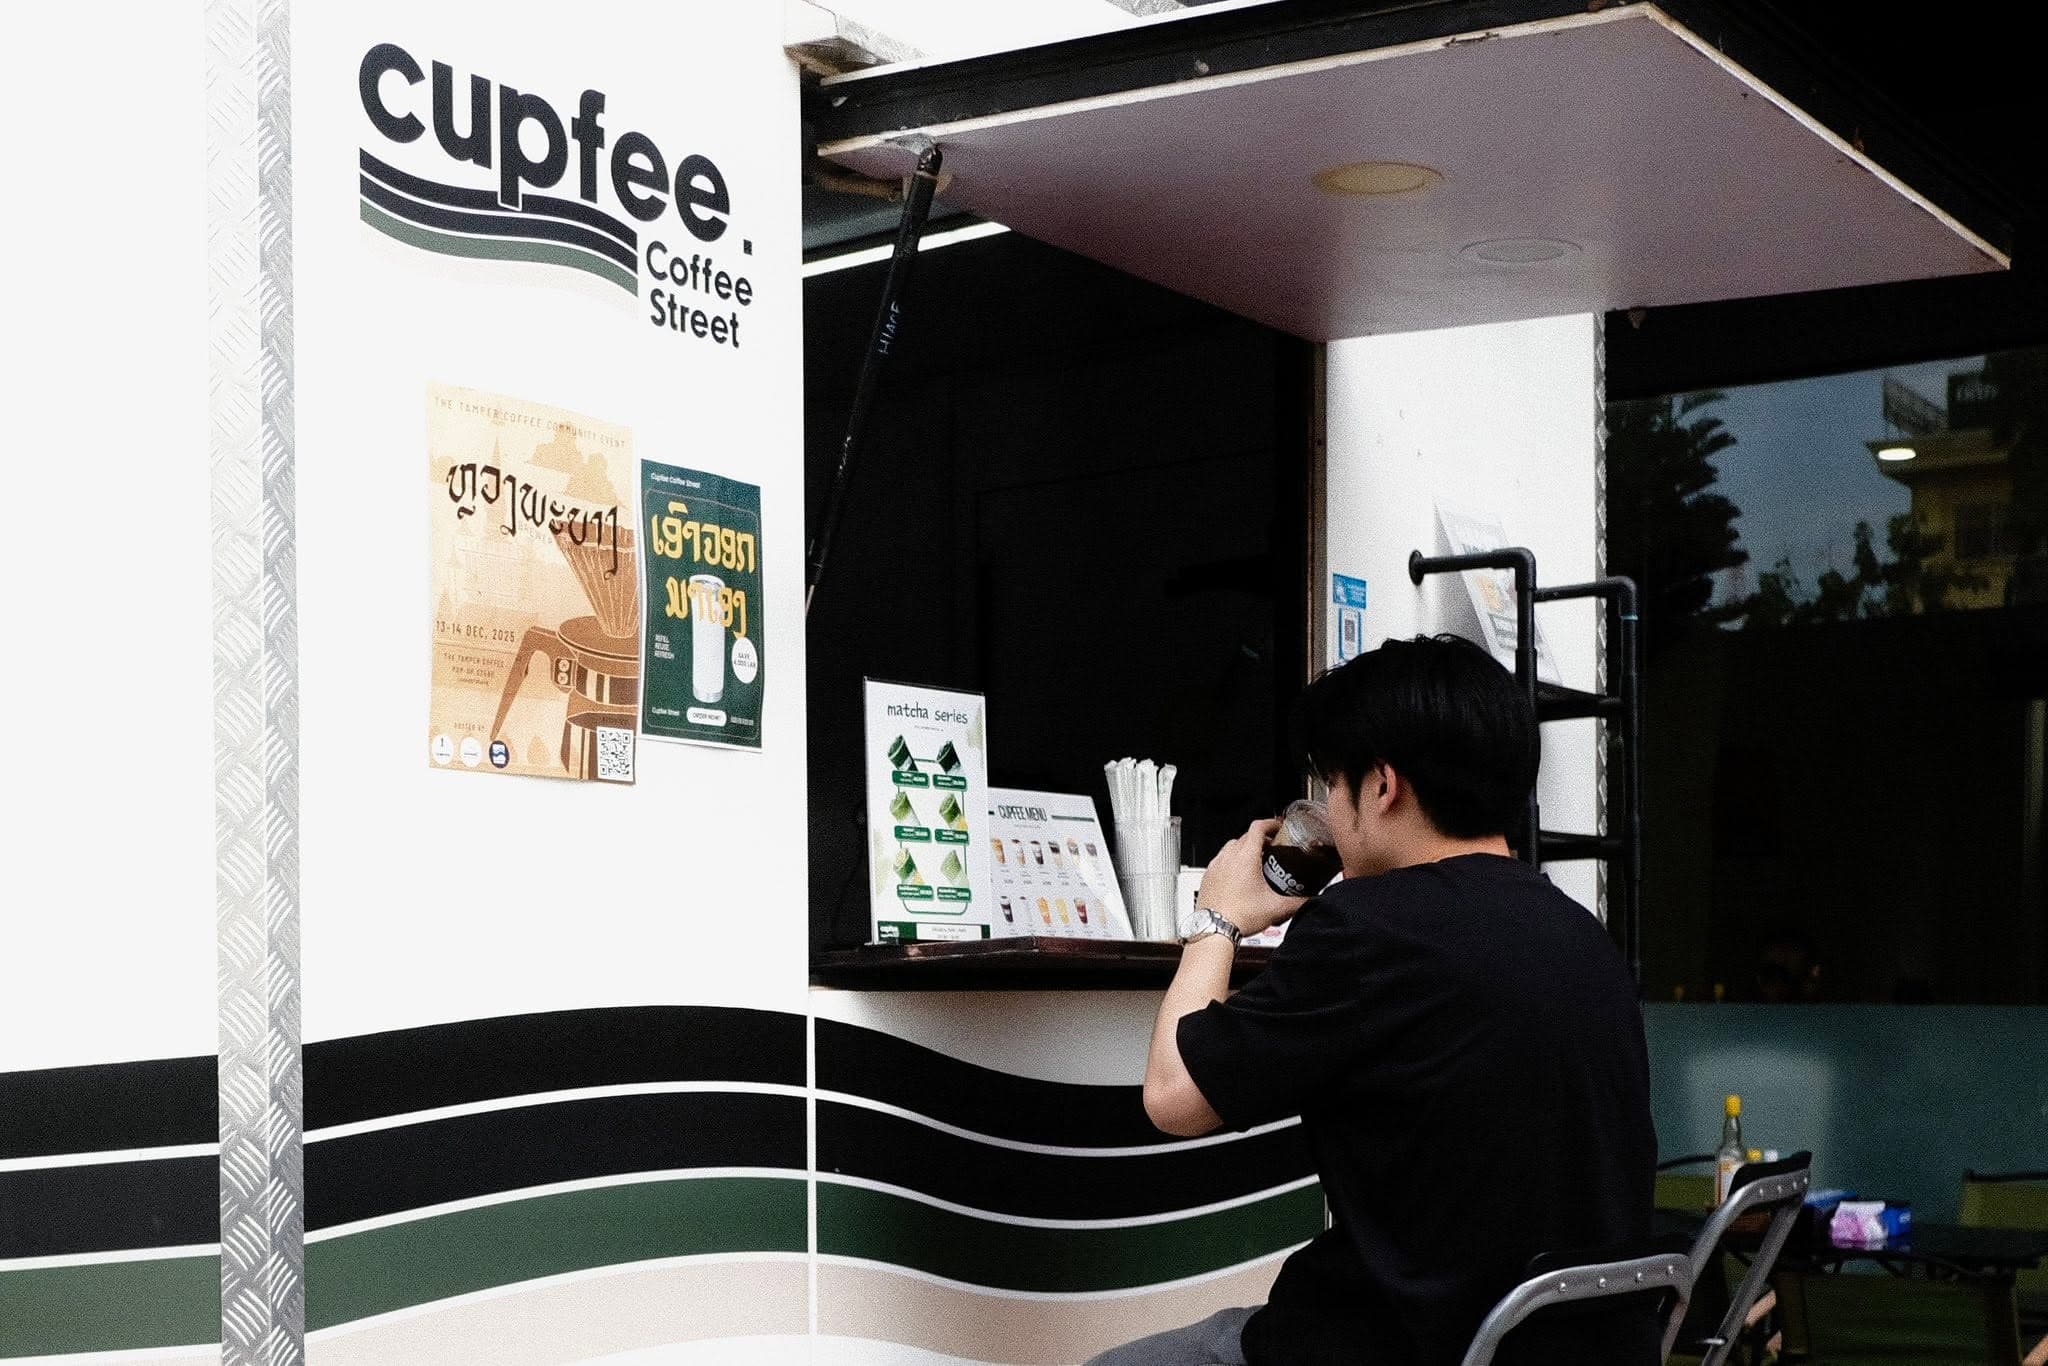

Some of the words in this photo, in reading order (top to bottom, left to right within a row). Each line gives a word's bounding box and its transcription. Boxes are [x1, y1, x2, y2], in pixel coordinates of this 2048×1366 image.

[646, 241, 753, 306] Coffee
[650, 288, 740, 348] Street
[435, 396, 453, 410] THE
[459, 402, 500, 419] TAMPER
[503, 411, 542, 428] COFFEE
[436, 620, 462, 634] 13-14
[492, 628, 515, 643] 2025
[887, 701, 929, 720] matcha
[934, 708, 969, 725] series
[998, 805, 1026, 821] CUPFEE
[1025, 807, 1048, 822] MENU
